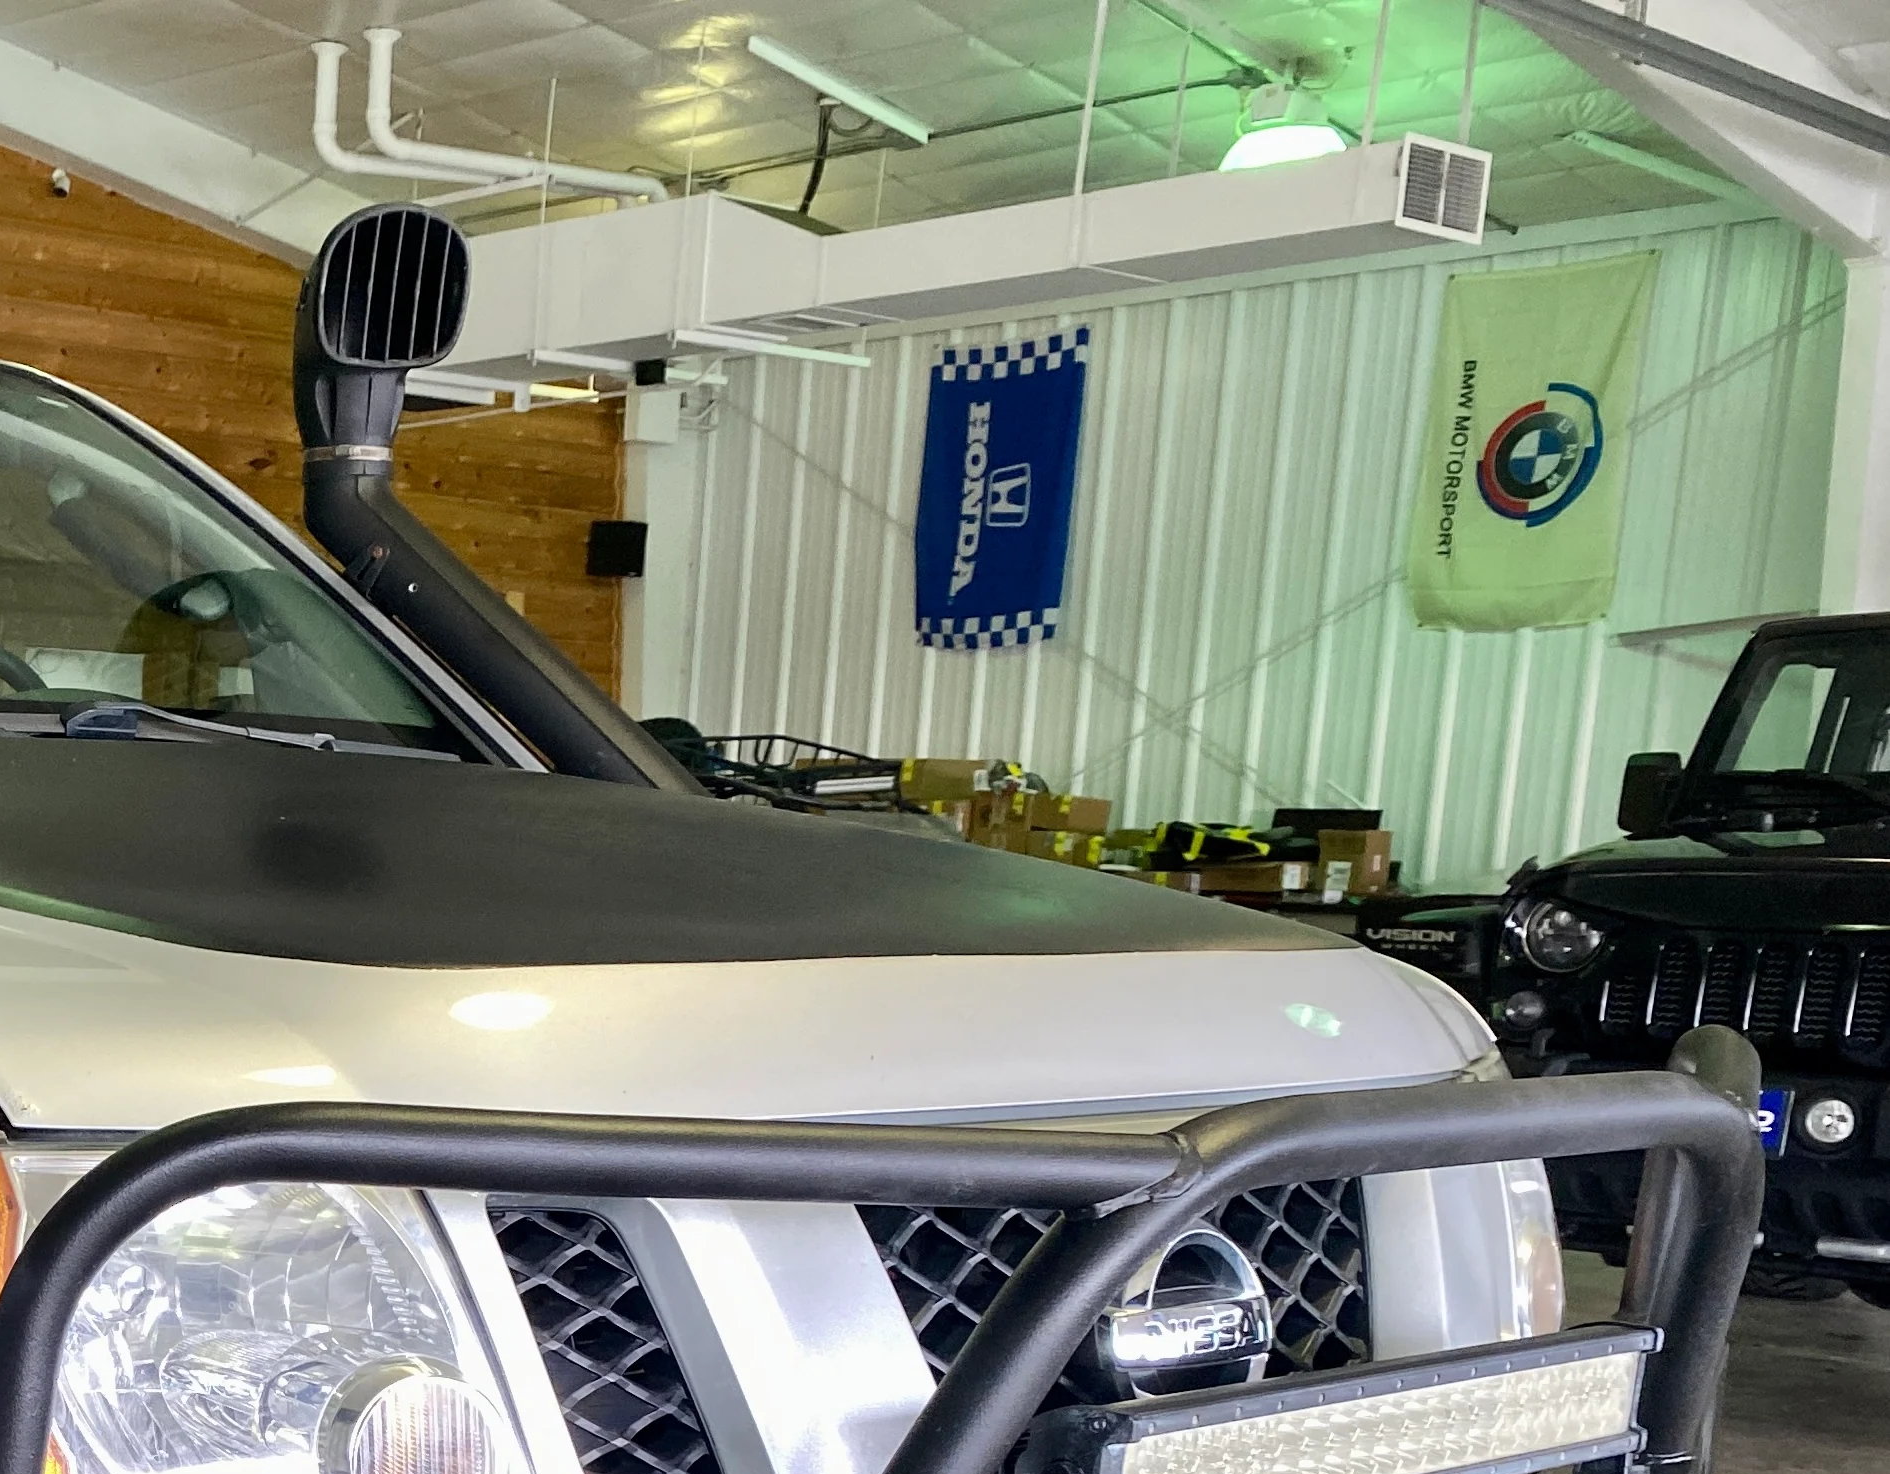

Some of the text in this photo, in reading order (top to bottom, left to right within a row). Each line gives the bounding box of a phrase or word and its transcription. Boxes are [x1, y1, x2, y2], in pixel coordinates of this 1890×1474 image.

[948, 401, 992, 597] HONDA
[1435, 359, 1478, 560] BMW MOTORSPORT
[1365, 927, 1457, 943] VISION
